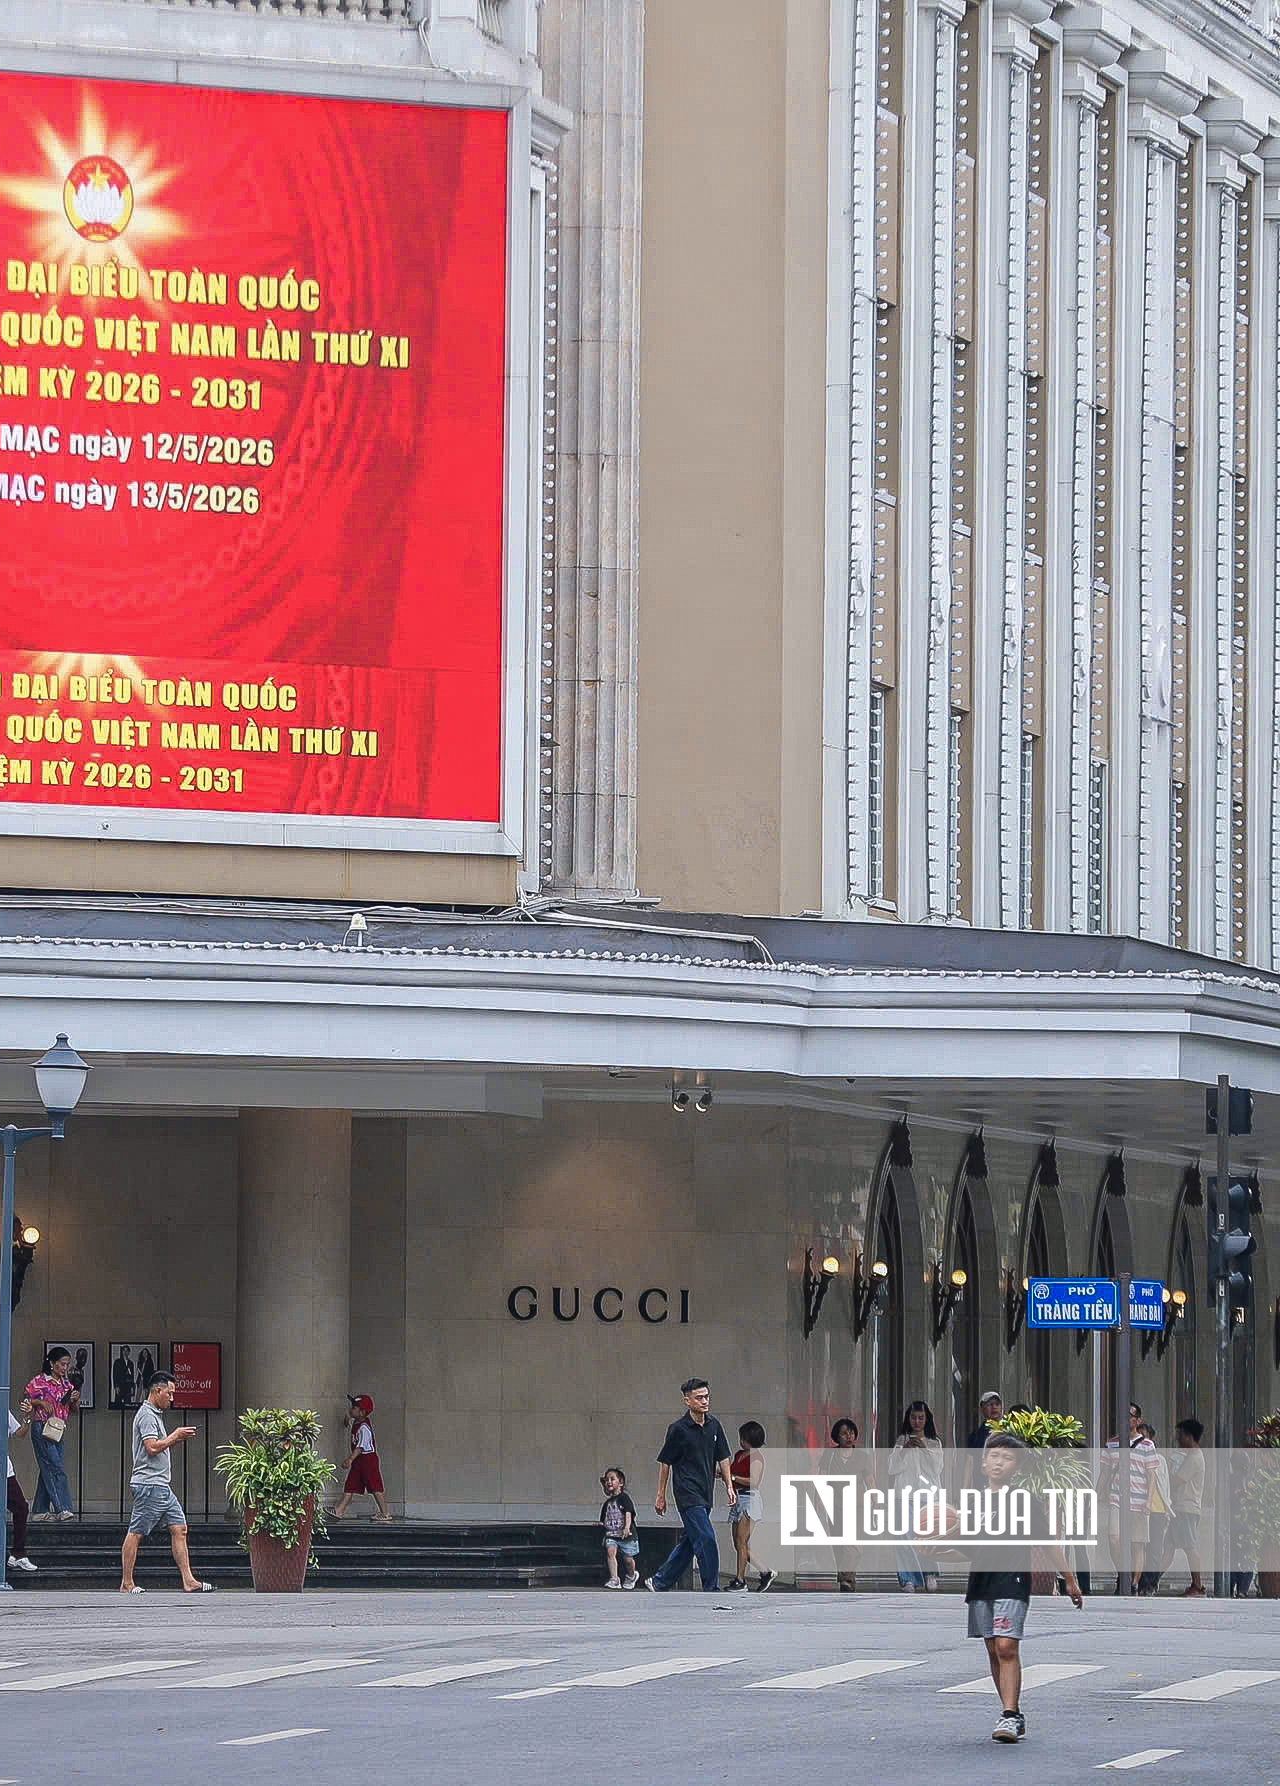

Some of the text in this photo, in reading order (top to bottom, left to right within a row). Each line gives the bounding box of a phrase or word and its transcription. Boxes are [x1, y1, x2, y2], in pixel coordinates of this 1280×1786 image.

[7, 260, 58, 299] ĐẠI
[70, 256, 139, 300] BIỂU
[149, 266, 228, 305] TOÀN
[238, 268, 320, 312] QUỐC
[0, 304, 84, 348] QUỐC
[94, 314, 160, 358] VIỆT
[171, 322, 237, 358] NAM
[247, 318, 300, 363] LẦN
[311, 330, 373, 366] THỨ
[379, 336, 409, 369] XI
[39, 364, 76, 399] KỲ
[85, 371, 161, 405] 2026
[170, 390, 182, 398] -
[191, 376, 263, 411] 2031
[0, 424, 60, 458] MẠC
[69, 429, 132, 463] ngày
[141, 433, 274, 467] 12/5/2026
[54, 477, 117, 511] ngày
[126, 481, 259, 515] 13/5/2026
[12, 672, 58, 704] ĐẠI
[70, 668, 132, 704] BIỂU
[142, 677, 212, 707] TOÀN
[222, 677, 297, 711] QUỐC
[6, 709, 83, 743] QUỐC
[91, 716, 151, 751] VIỆT
[161, 722, 221, 750] NAM
[230, 717, 279, 752] LẦN
[288, 727, 345, 755] THỨ
[351, 730, 378, 757] XI
[41, 757, 74, 786] KỲ
[83, 762, 152, 788] 2026
[179, 766, 244, 793] 2031
[508, 1285, 690, 1324] GUCCI
[1068, 1282, 1096, 1296] PHỐ
[1141, 1284, 1154, 1297] PHỐ
[1036, 1297, 1113, 1321] TRÀNG TIỀN
[1129, 1300, 1161, 1322] HÀNG BÀI
